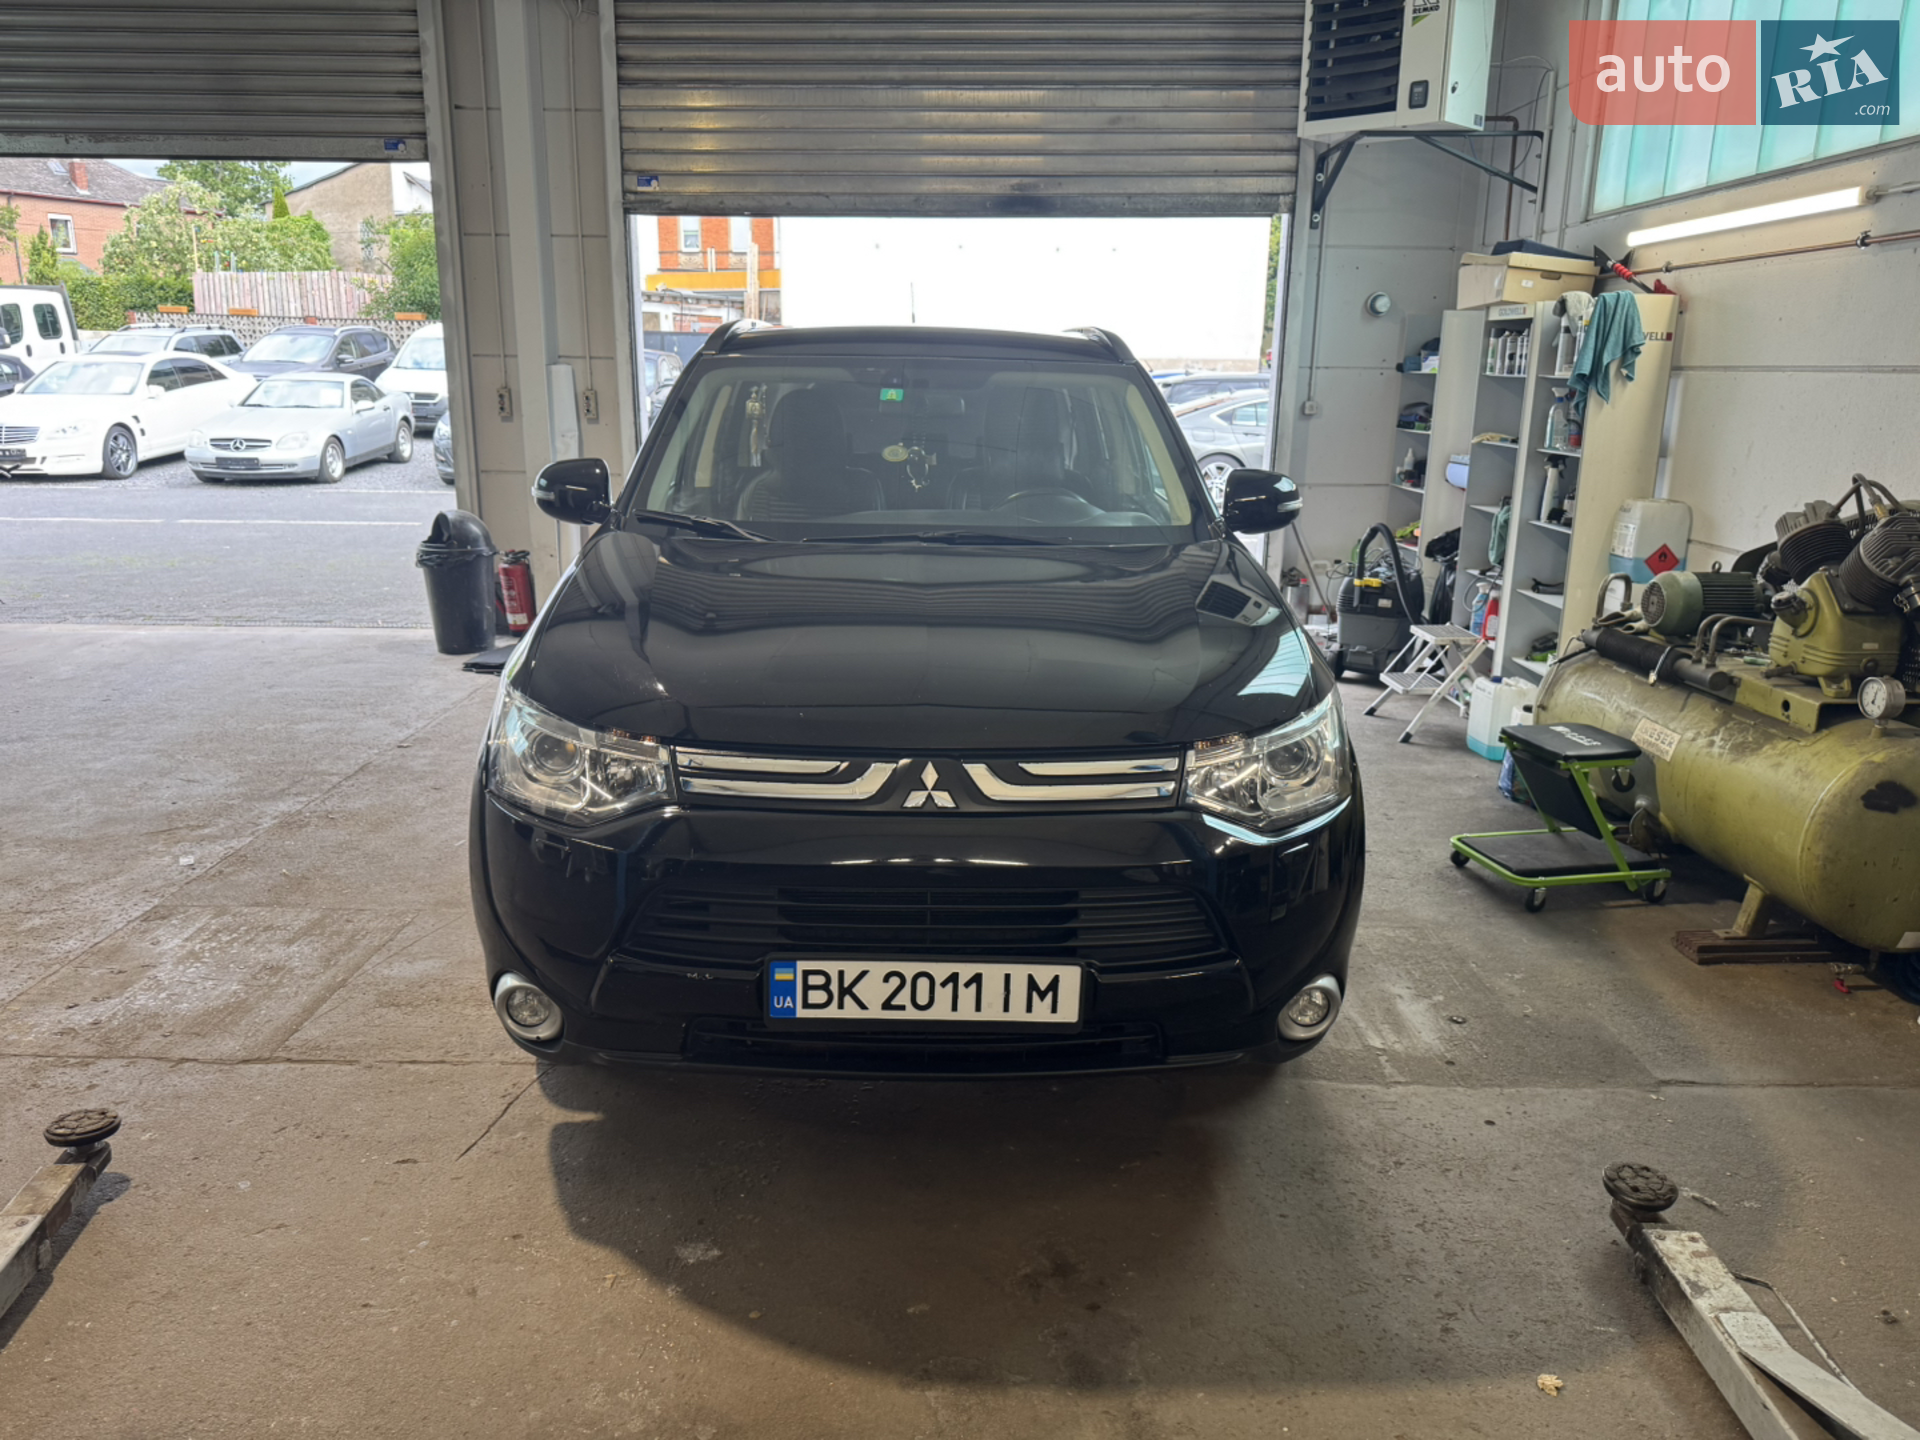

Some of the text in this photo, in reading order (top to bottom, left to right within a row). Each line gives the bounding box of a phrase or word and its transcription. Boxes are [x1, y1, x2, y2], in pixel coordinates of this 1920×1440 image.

[1412, 4, 1440, 15] REMKO
[801, 968, 870, 1010] BK
[880, 969, 984, 1012] 2011
[774, 995, 794, 1009] UA
